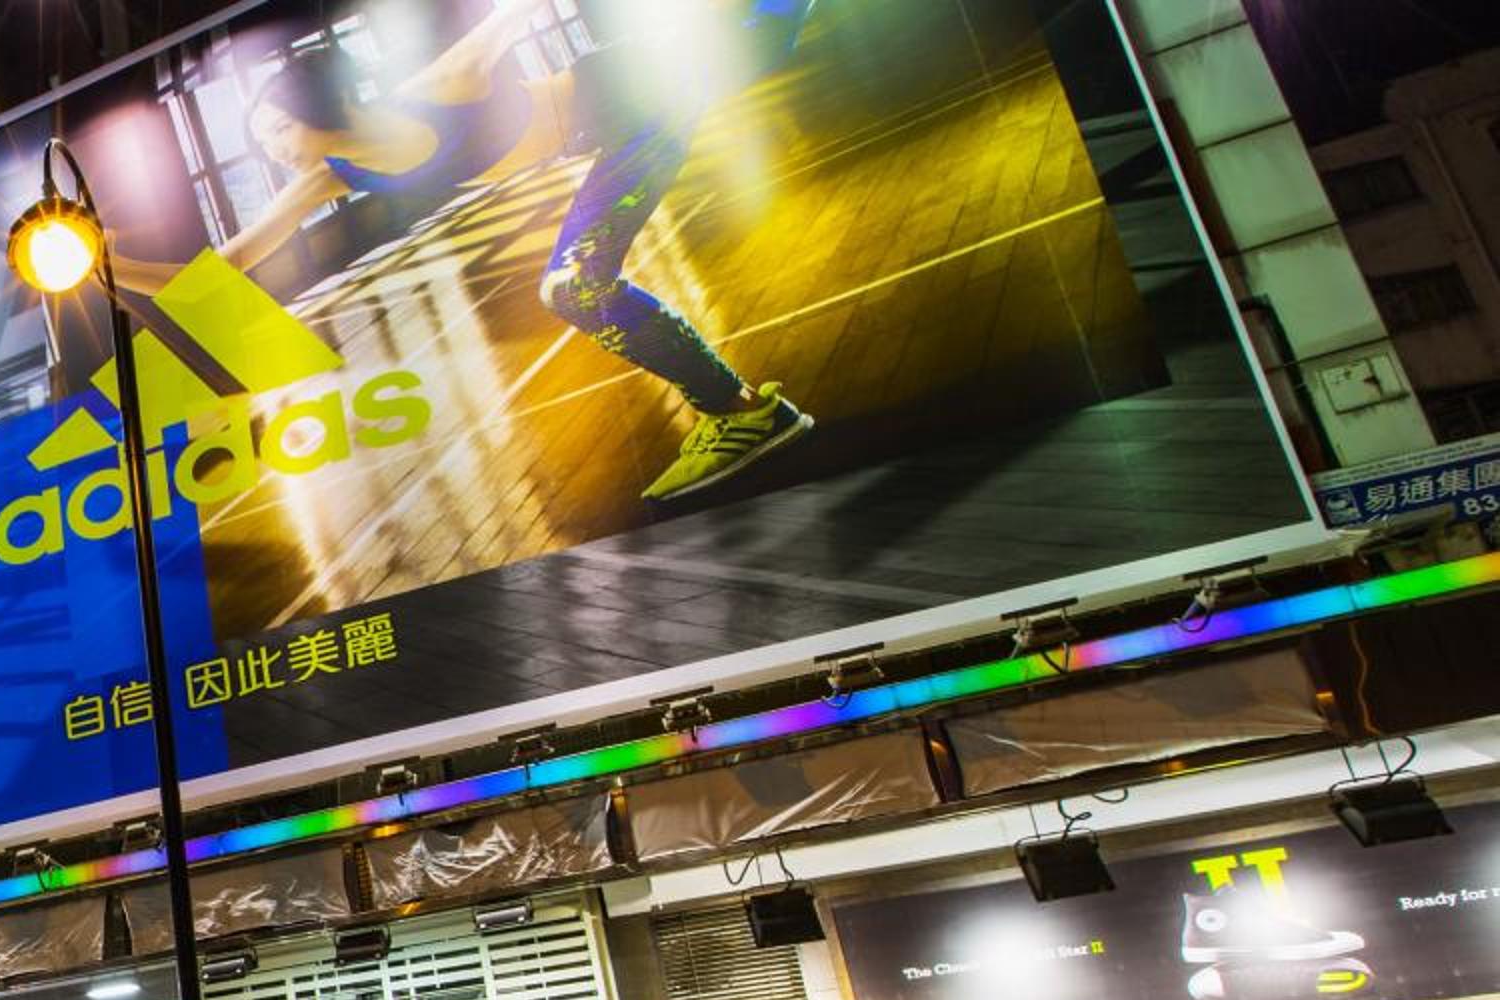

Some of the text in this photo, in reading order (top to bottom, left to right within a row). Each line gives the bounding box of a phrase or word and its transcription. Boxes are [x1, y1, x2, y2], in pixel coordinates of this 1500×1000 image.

[63, 612, 398, 740] 自信 因此美麗
[1398, 891, 1457, 911] Ready
[902, 966, 932, 981] The
